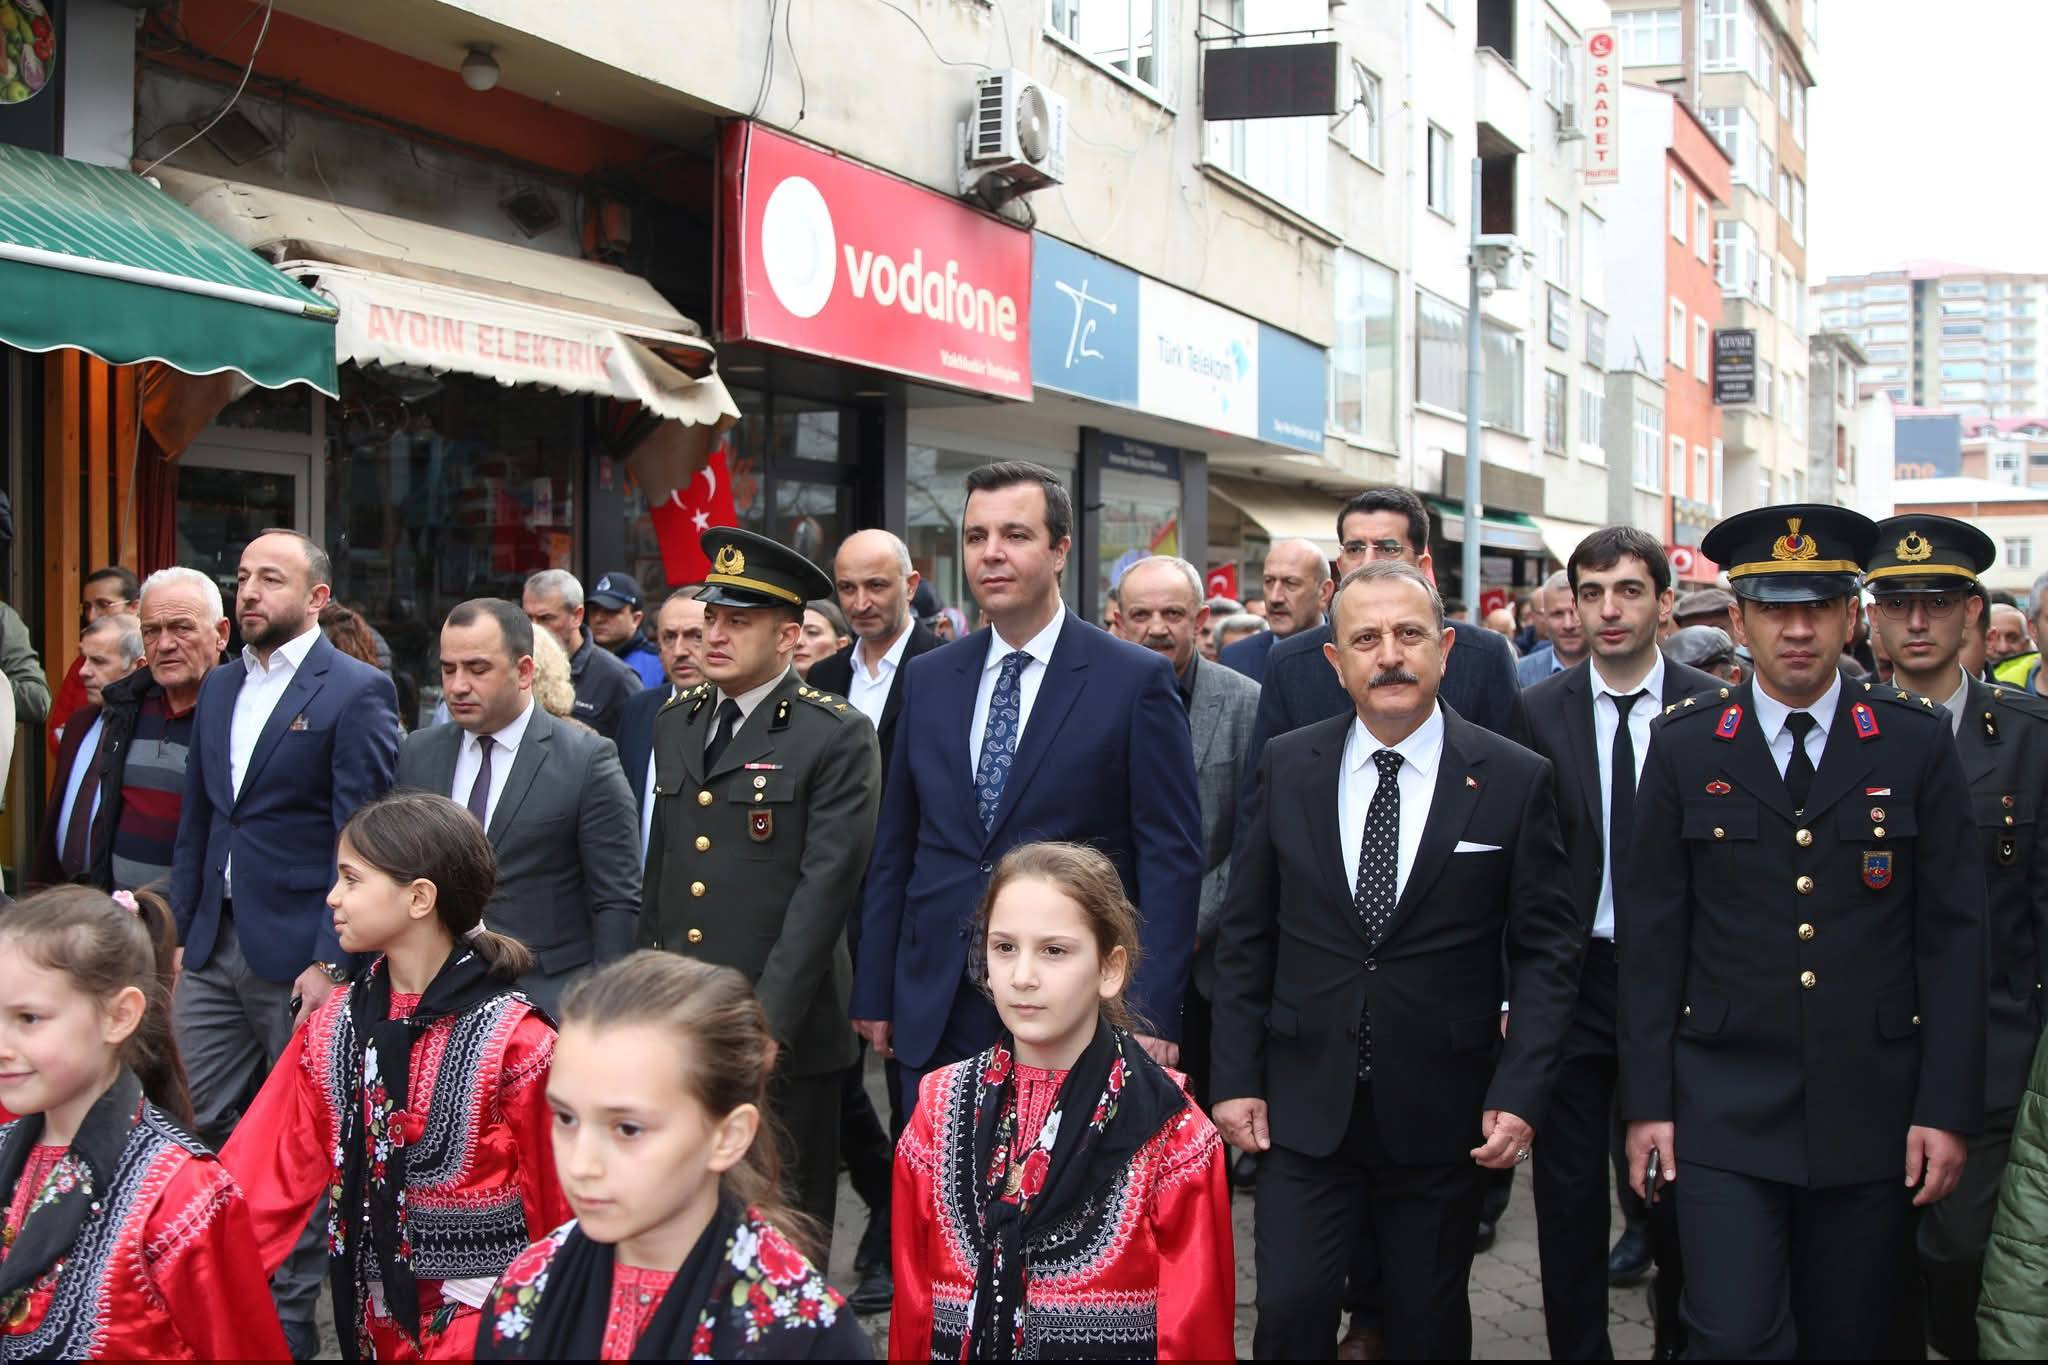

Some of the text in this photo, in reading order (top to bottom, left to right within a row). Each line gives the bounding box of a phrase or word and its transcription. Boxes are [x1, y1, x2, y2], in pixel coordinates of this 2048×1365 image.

[1594, 65, 1609, 162] SAADET
[843, 244, 1017, 342] vodafone
[367, 304, 614, 378] AYDIN ELEKTRİK
[1157, 335, 1235, 382] Türk Telekom
